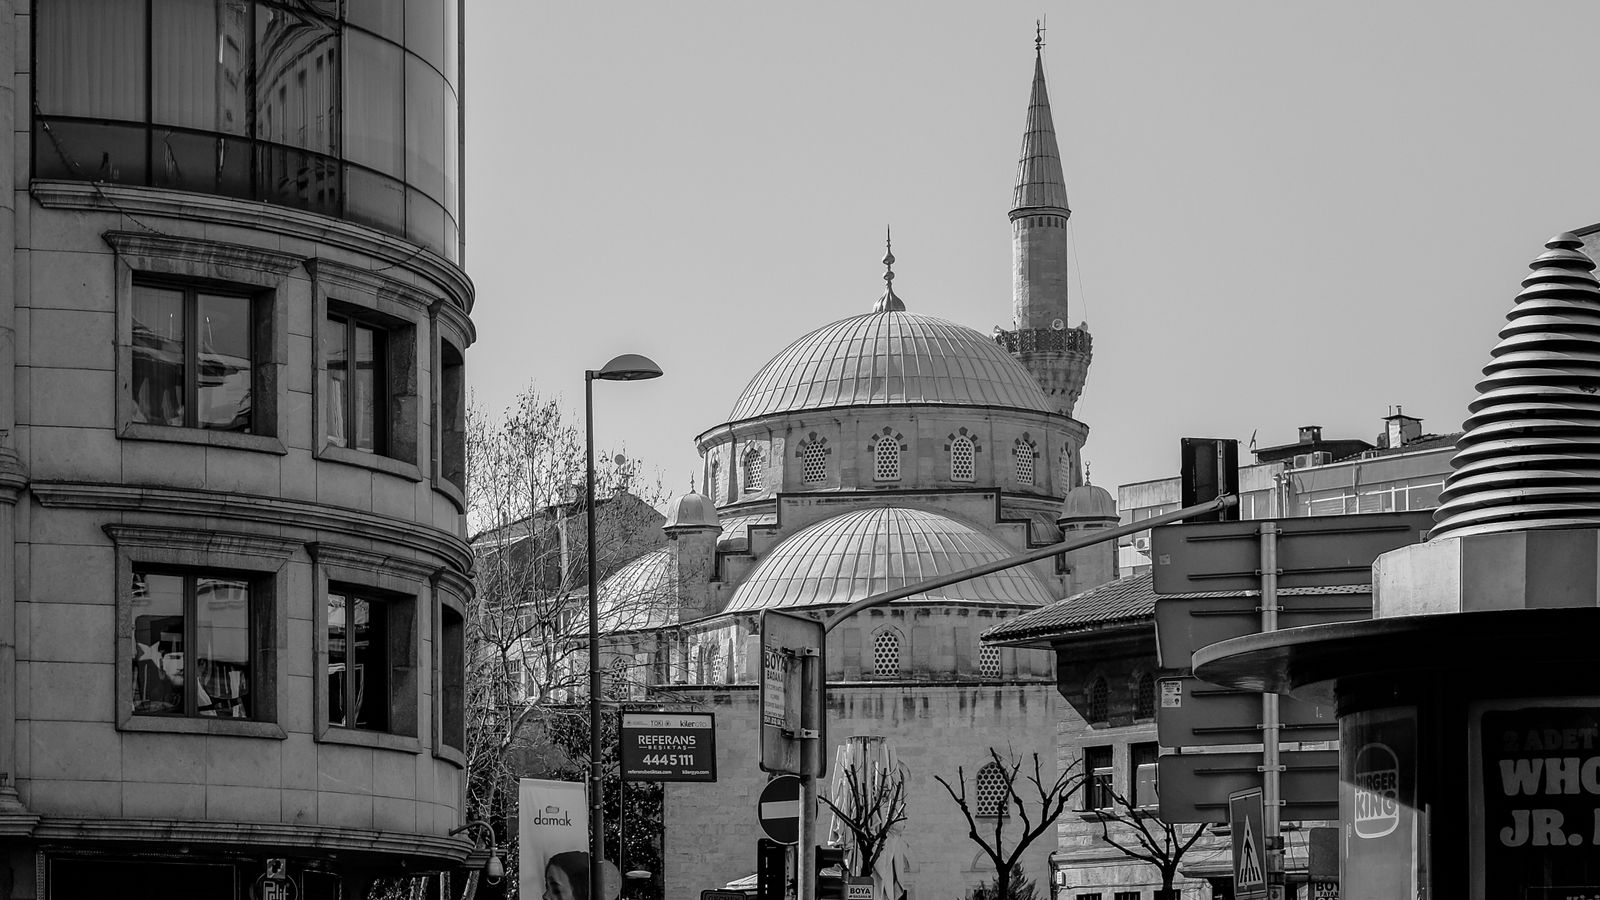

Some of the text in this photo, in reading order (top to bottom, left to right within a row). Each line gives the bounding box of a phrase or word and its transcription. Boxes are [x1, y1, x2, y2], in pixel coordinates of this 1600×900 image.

[638, 735, 696, 745] REFERANS
[1356, 770, 1397, 791] BURGER
[1355, 785, 1396, 820] KING
[533, 809, 572, 827] damak
[1499, 808, 1583, 847] JR.
